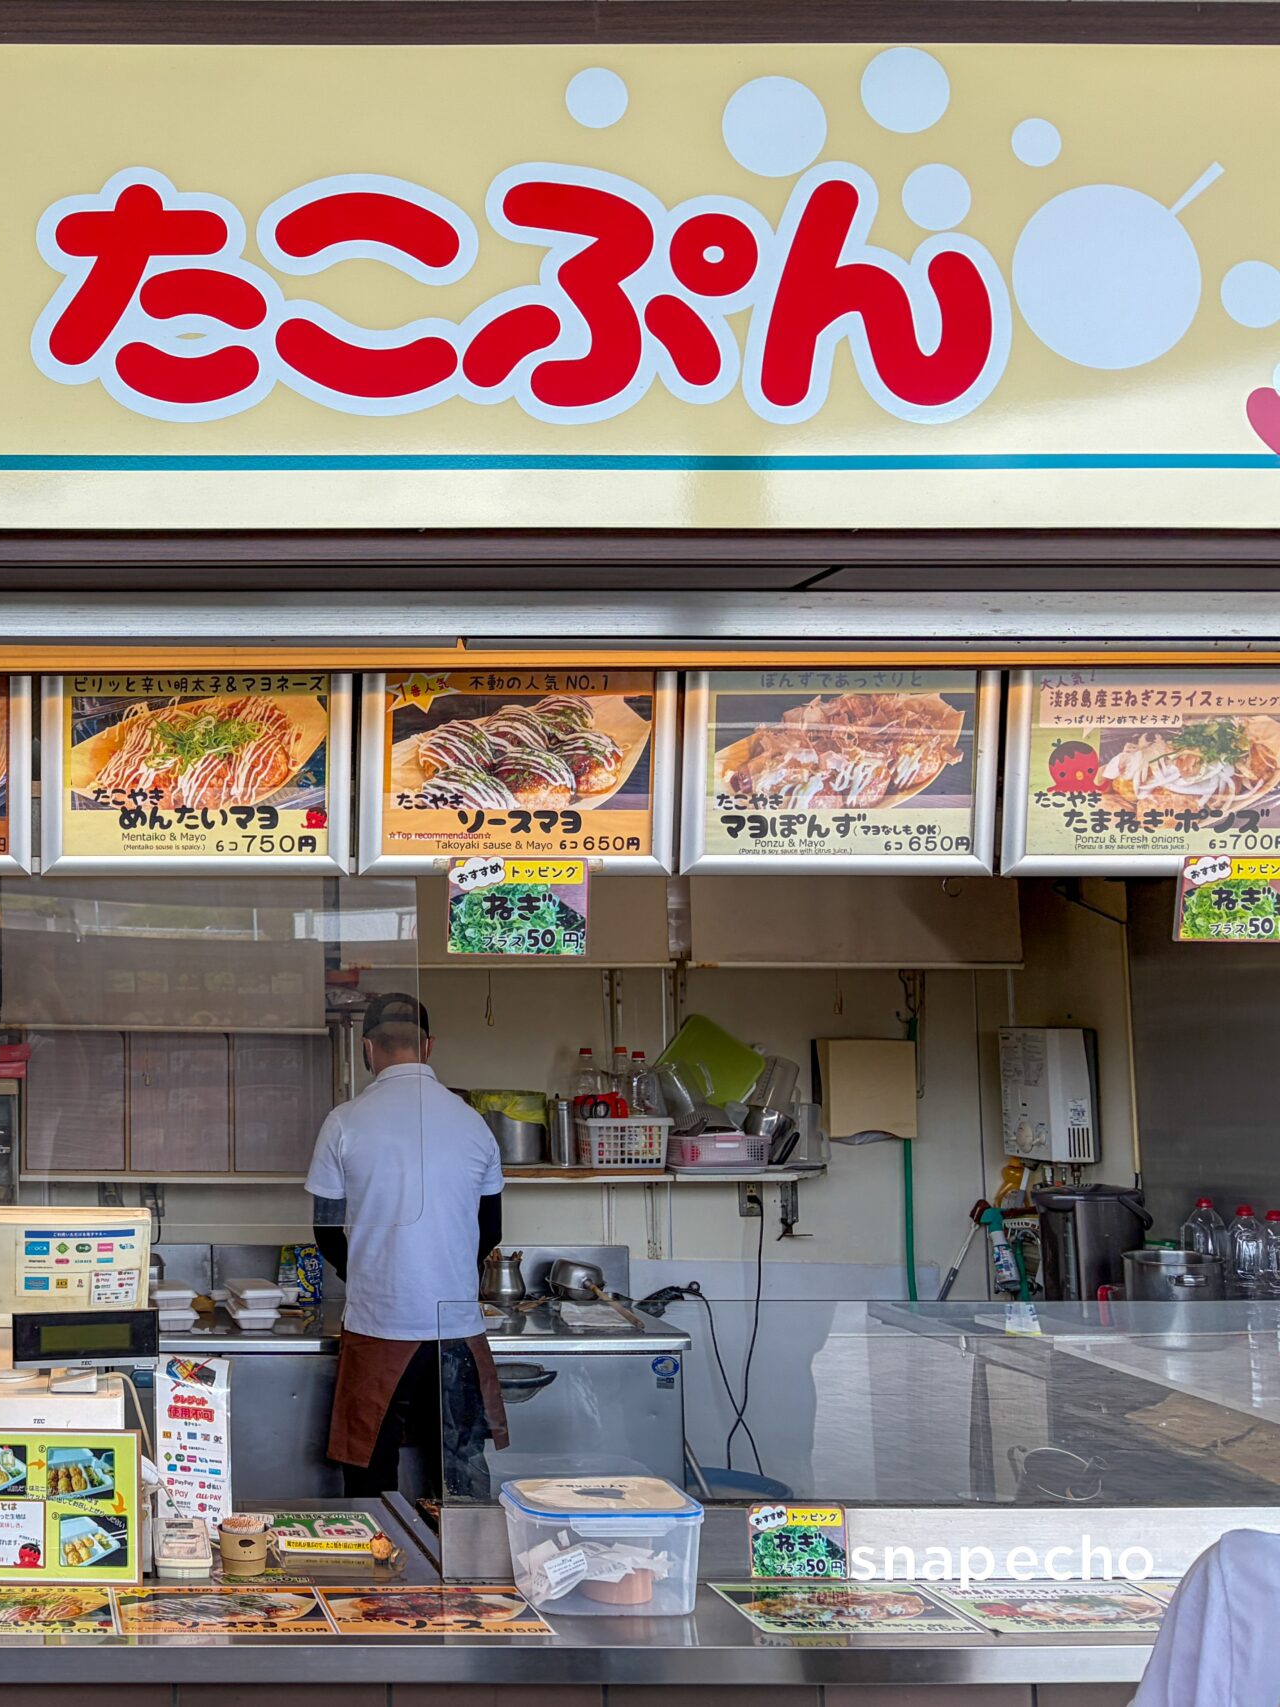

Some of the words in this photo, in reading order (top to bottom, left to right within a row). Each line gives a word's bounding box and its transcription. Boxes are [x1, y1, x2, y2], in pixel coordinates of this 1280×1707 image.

[48, 178, 993, 408] たこぷん
[92, 788, 164, 805] たこやき
[396, 793, 464, 810] たこやき
[716, 794, 784, 810] たこやき
[1034, 791, 1102, 807] たこやき
[119, 806, 279, 830] めんたいマヨ
[457, 810, 582, 834] ソースマヨ
[720, 813, 867, 838] マヨぽんず
[1063, 809, 1270, 834] たまねぎポンズ
[122, 833, 166, 841] Mentaiko
[170, 833, 177, 841] &
[180, 833, 206, 842] Mayo
[436, 840, 480, 851] Takoyaki
[515, 841, 523, 850] &
[526, 841, 553, 851] Mayo
[755, 839, 784, 847] Ponzu
[788, 839, 795, 847] &
[799, 839, 825, 849] Mayo
[1075, 834, 1106, 844] Ponzu
[1120, 834, 1148, 844] Fresh
[1151, 834, 1184, 844] onions
[457, 863, 502, 884] おすすめ
[512, 866, 577, 878] トッピング
[1190, 861, 1229, 879] おすすめ
[483, 893, 553, 921] ねぎ
[1212, 887, 1272, 911] ねぎ
[167, 1405, 215, 1421] 使用不可
[754, 1510, 785, 1526] おすすめ
[790, 1512, 837, 1523] トッピング
[773, 1532, 821, 1553] ねぎ
[395, 1619, 485, 1629] ソース
